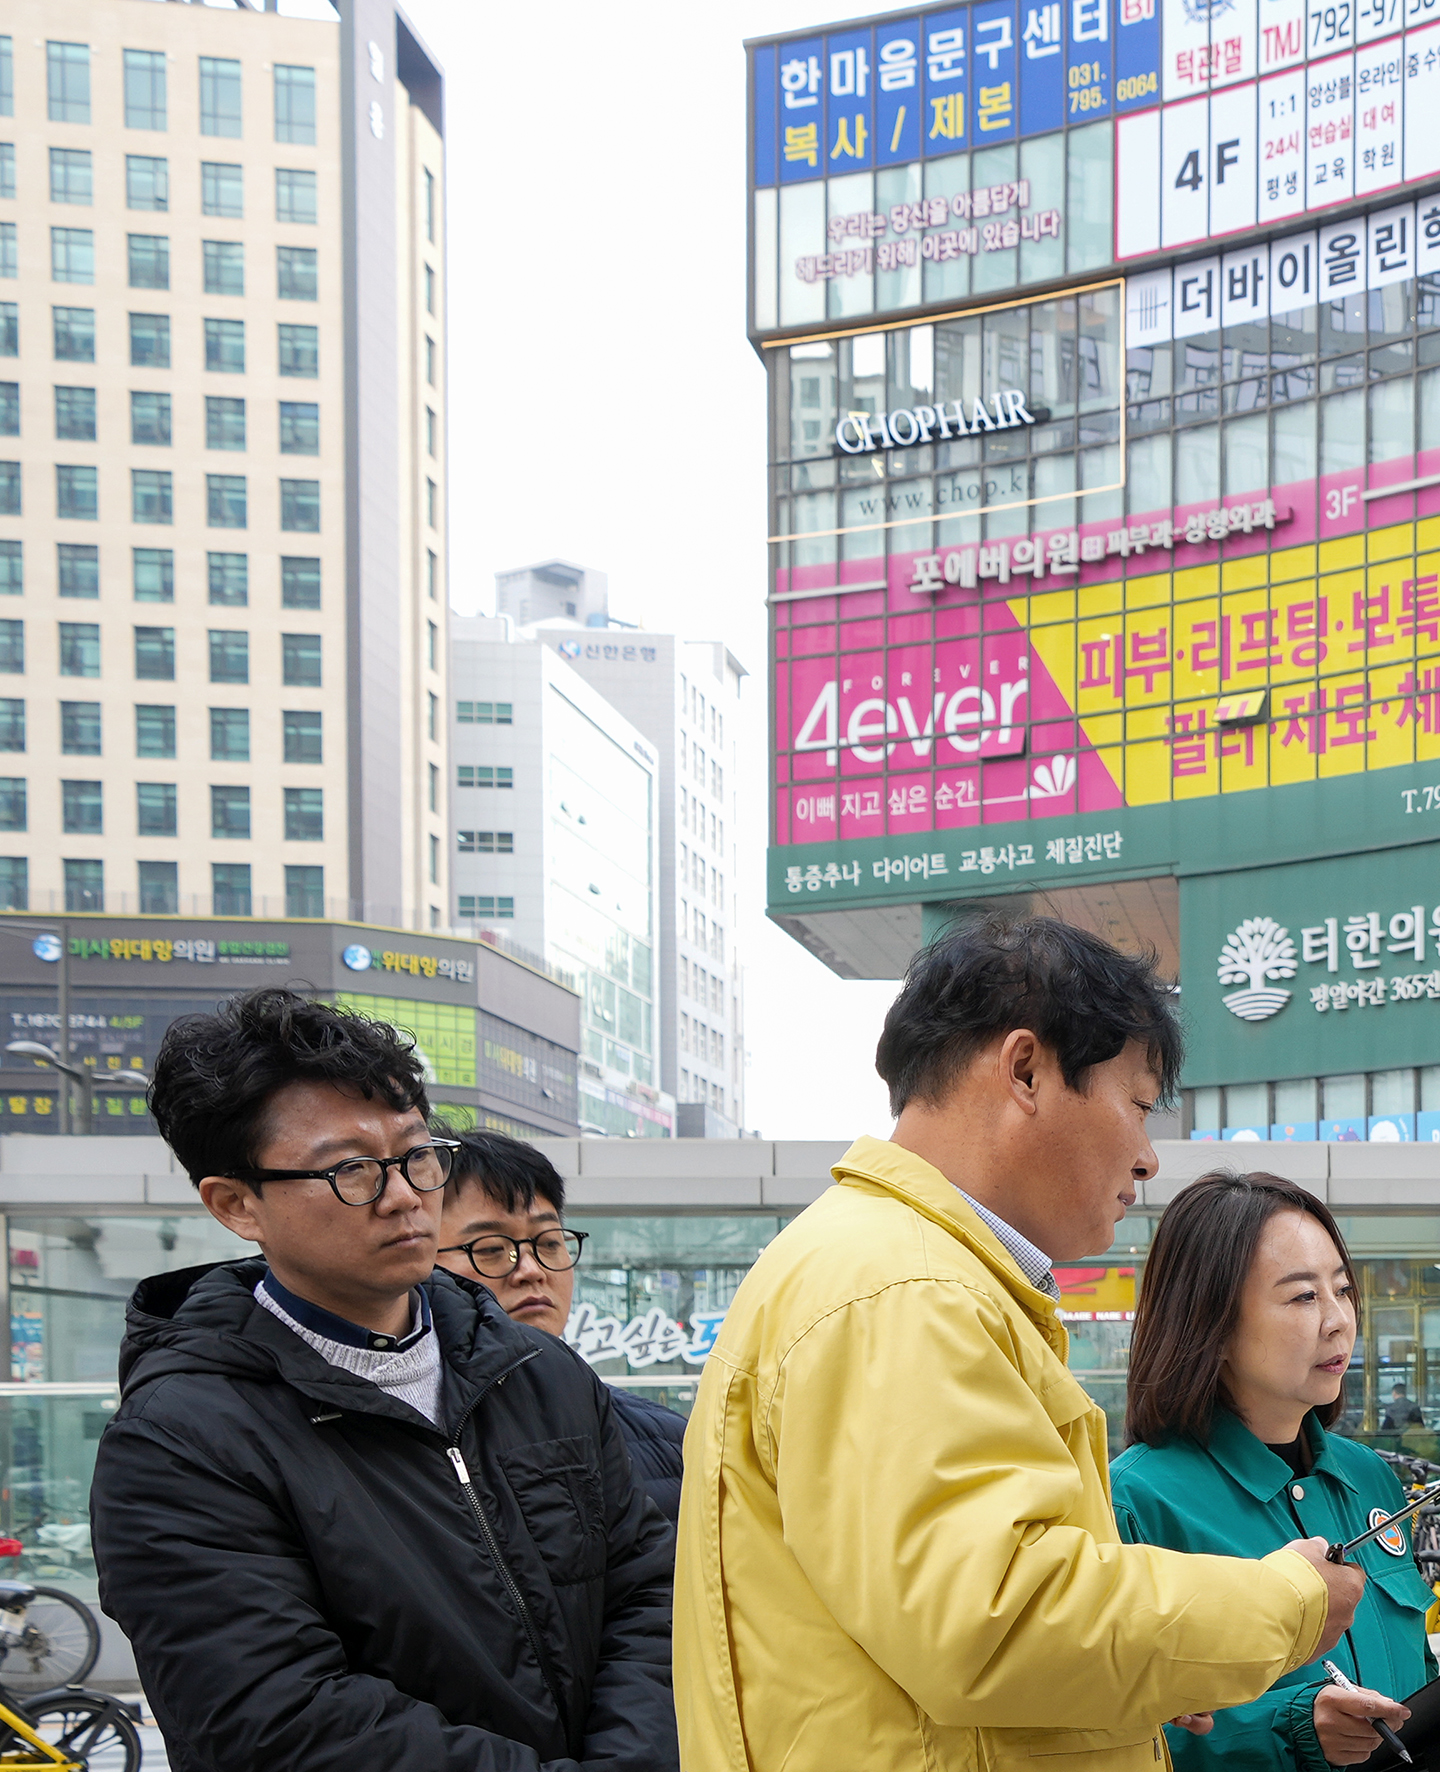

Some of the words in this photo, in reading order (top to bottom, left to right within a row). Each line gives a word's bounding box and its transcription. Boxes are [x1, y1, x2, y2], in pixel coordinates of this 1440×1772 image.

[781, 0, 1111, 108] 한마음문구센터
[1176, 36, 1242, 84] 턱관절
[1262, 19, 1301, 63] TMJ
[1309, 71, 1351, 109] 앙상블
[1358, 59, 1400, 94] 온라인
[1407, 52, 1419, 79] 줌
[1117, 72, 1158, 101] 6064
[784, 118, 868, 168] 복사
[929, 83, 1012, 141] 제본
[1265, 130, 1300, 160] 24시
[1309, 114, 1351, 149] 연습실
[828, 208, 886, 245] 우리는
[890, 195, 949, 236] 당신을
[952, 179, 1030, 227] 아름답게
[796, 246, 874, 283] 해드리기
[876, 239, 916, 269] 위해
[921, 229, 977, 263] 이곳에
[981, 209, 1061, 252] 있습니다
[834, 389, 1034, 454] CHOPHAIR
[1324, 486, 1359, 521] 3F
[909, 519, 1079, 595] 포에버의원
[586, 642, 657, 662] 신한은행
[794, 667, 1029, 767] 4ever
[841, 790, 880, 818] 지고
[887, 785, 928, 816] 싶은
[934, 778, 976, 809] 순간
[784, 859, 861, 894] 통증추나
[872, 852, 948, 884] 다이어트
[959, 842, 1034, 875] 교통사고
[1046, 831, 1122, 864] 체질진단
[1308, 980, 1386, 1014] 평일야간
